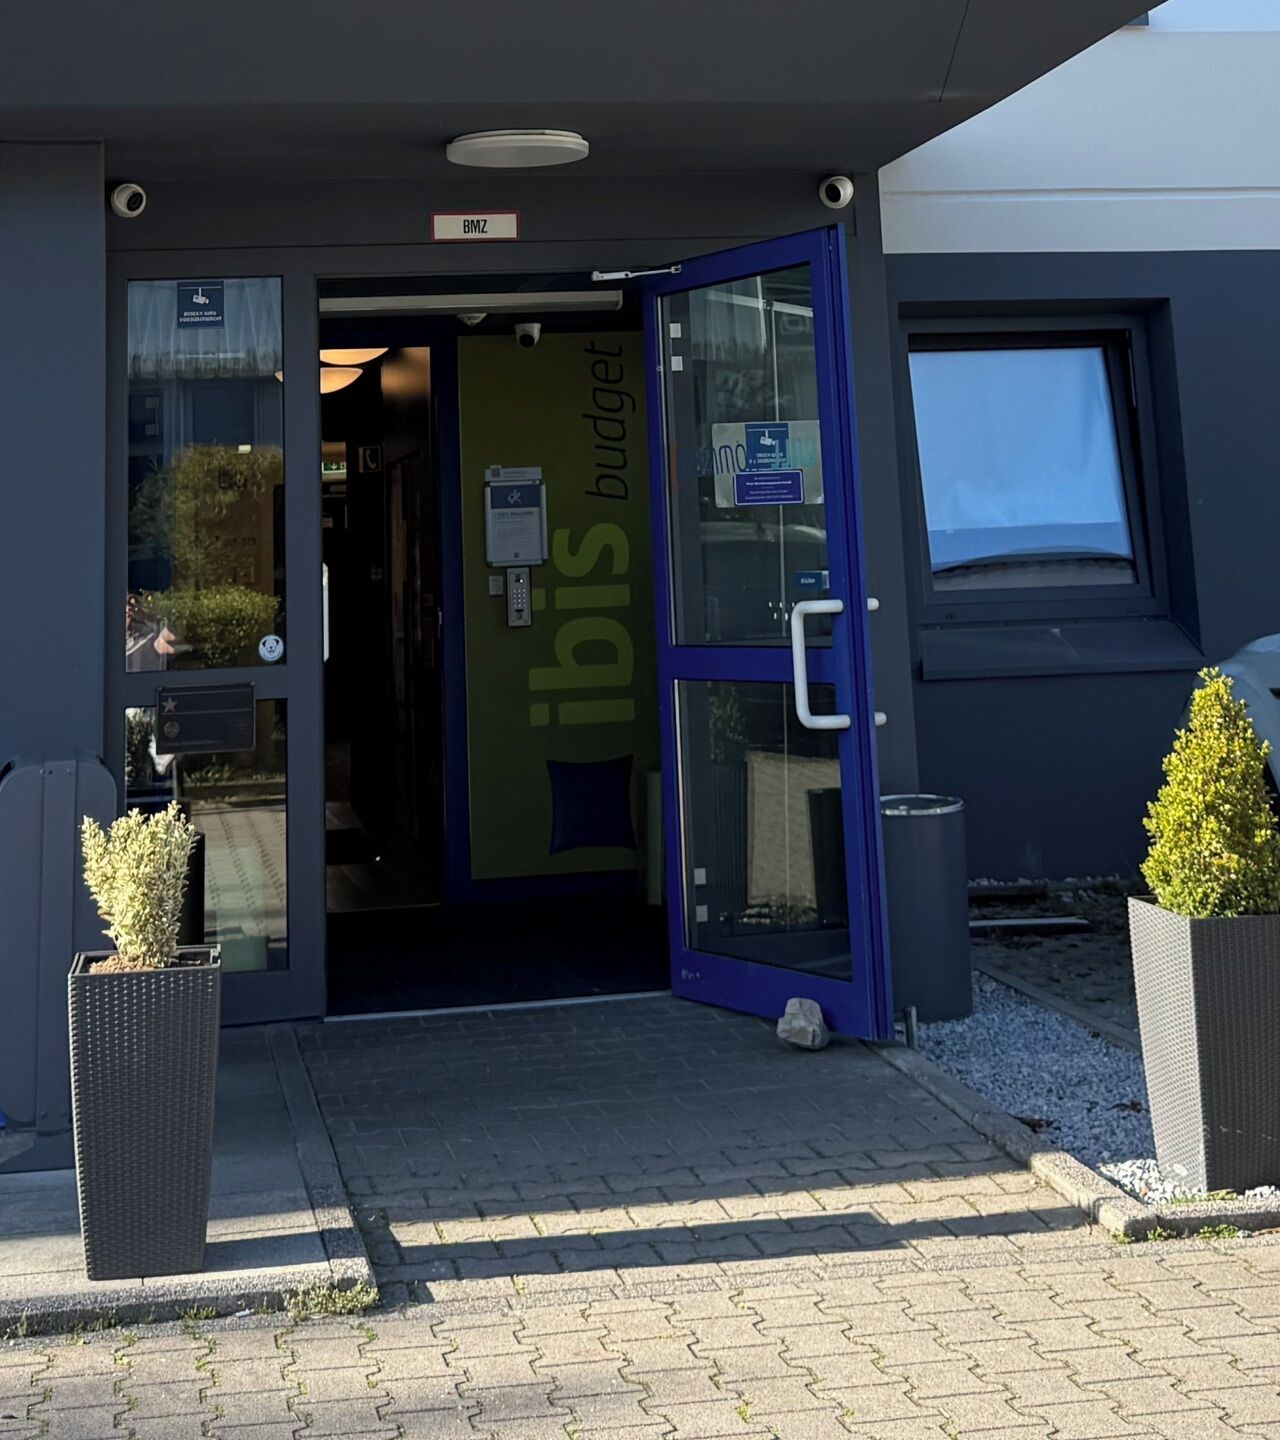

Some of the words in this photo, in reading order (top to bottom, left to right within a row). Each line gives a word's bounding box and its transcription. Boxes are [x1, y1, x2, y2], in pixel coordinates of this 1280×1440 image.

[463, 219, 488, 234] BMZ
[581, 340, 636, 501] budget
[528, 522, 636, 726] ibis
